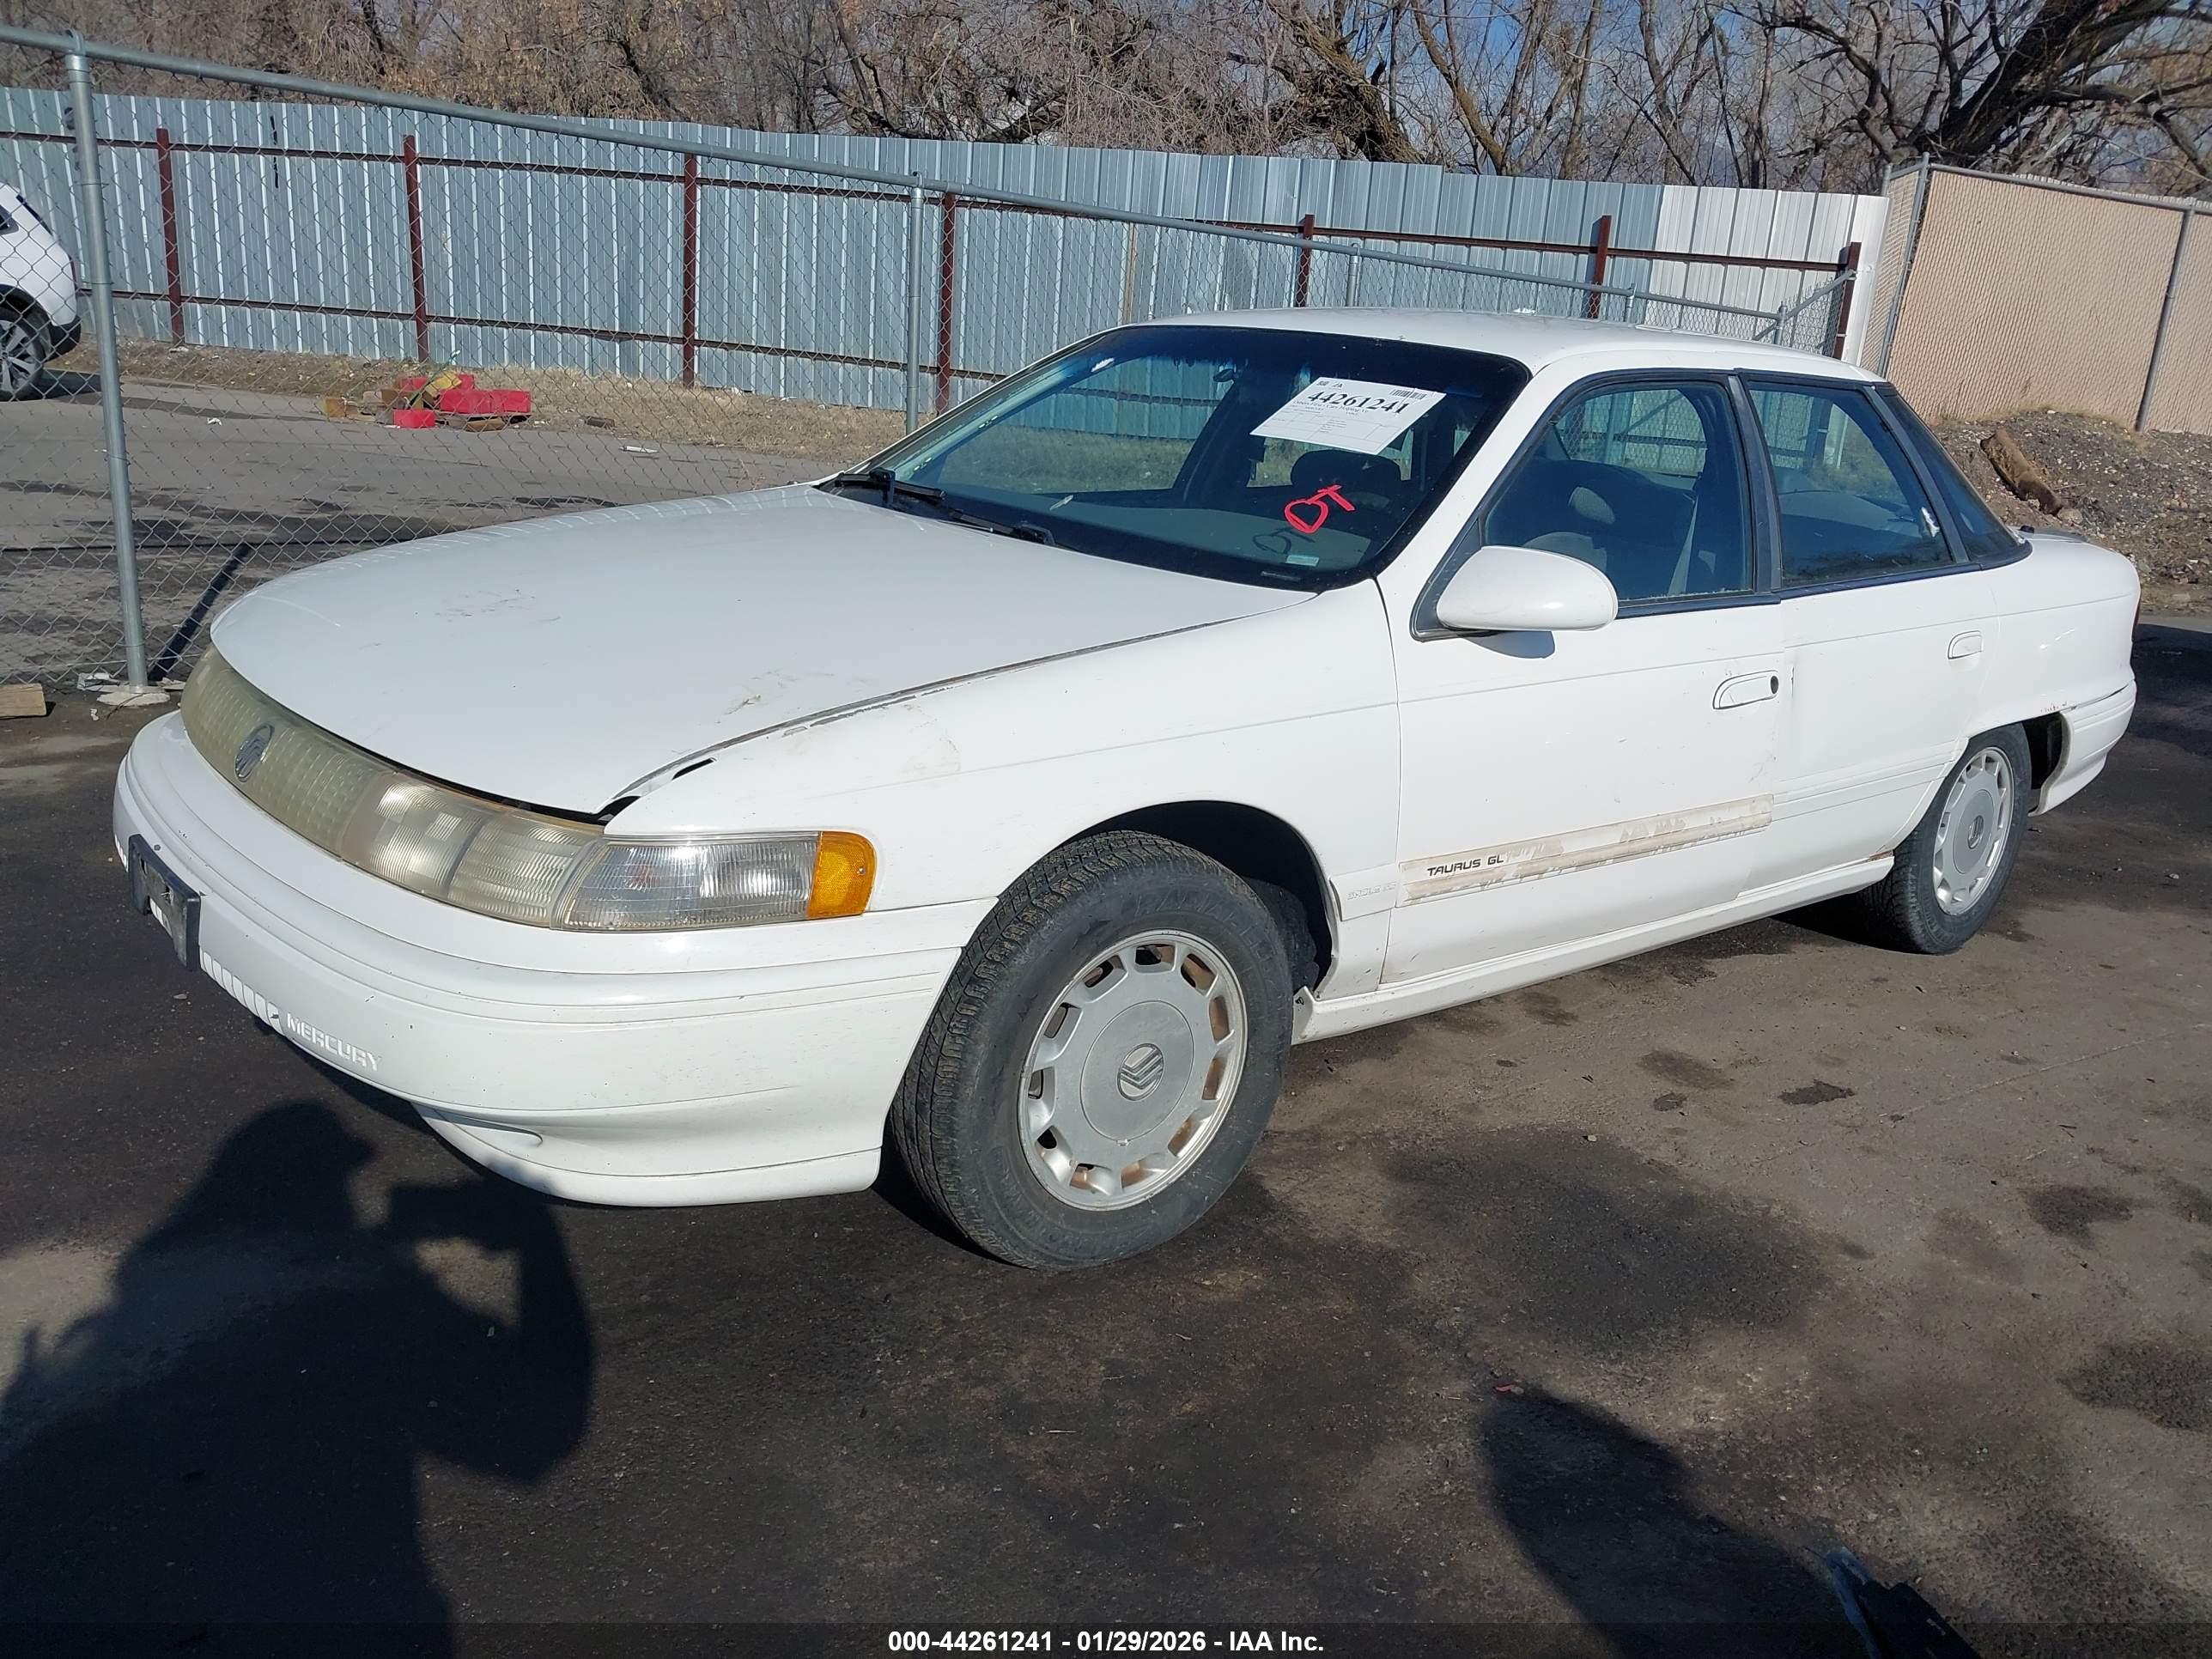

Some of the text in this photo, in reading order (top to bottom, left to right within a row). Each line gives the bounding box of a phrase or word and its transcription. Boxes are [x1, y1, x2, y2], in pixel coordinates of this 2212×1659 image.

[1308, 391, 1410, 414] 44261241
[1427, 855, 1504, 876] TAURUS GL
[287, 1012, 383, 1072] MERCURY
